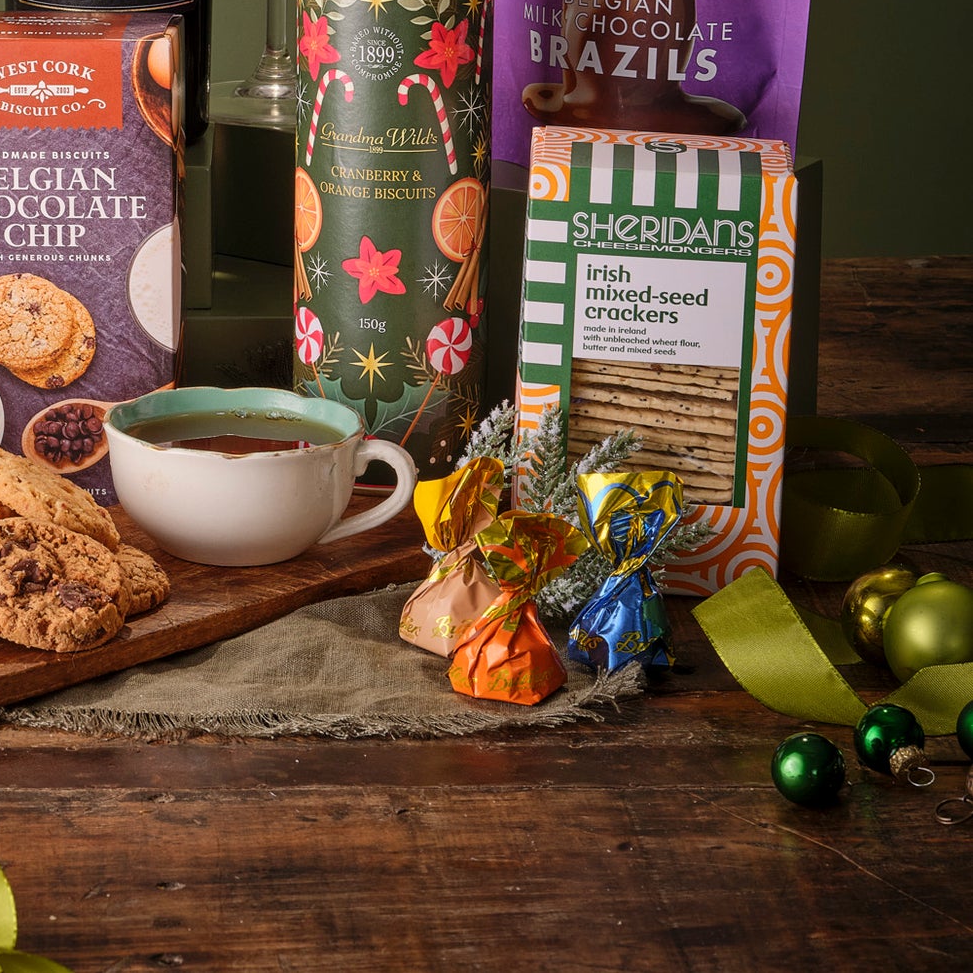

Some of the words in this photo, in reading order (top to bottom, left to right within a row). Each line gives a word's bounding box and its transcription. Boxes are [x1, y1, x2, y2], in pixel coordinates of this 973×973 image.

[524, 2, 563, 28] MILK
[574, 12, 733, 41] CHOCOLATE
[349, 27, 370, 52] BAKED
[373, 26, 404, 55] WITHOUT
[367, 39, 386, 47] SINCE
[359, 45, 395, 64] 1899
[529, 29, 718, 82] BRAZILS
[42, 60, 95, 82] CORK
[351, 59, 402, 81] COMPROMISE
[0, 101, 58, 117] BISCUIT
[62, 102, 86, 113] CO.
[320, 122, 384, 146] Grandma
[386, 127, 438, 148] Wild's
[52, 151, 110, 159] BISCUITS
[368, 146, 384, 154] 1899
[331, 166, 409, 182] CRANBERRY
[412, 170, 422, 182] &
[320, 181, 371, 199] ORANGE
[374, 186, 436, 200] BISCUITS
[4, 223, 86, 248] CHIP
[8, 253, 64, 262] GENEROUS
[68, 254, 111, 262] CHUNKS
[573, 240, 752, 256] CHEESEMONGERS
[586, 264, 631, 283] irish
[585, 284, 709, 307] mixed-seed
[584, 304, 679, 324] crackers
[358, 318, 387, 333] 150g
[583, 325, 607, 333] made
[617, 326, 647, 336] ireland
[582, 343, 608, 353] butter
[609, 345, 625, 353] and
[627, 346, 652, 354] mixed
[654, 347, 677, 356] seeds
[583, 334, 601, 342] with
[603, 335, 650, 345] unbleached
[652, 338, 678, 347] wheat
[679, 339, 701, 349] flour,
